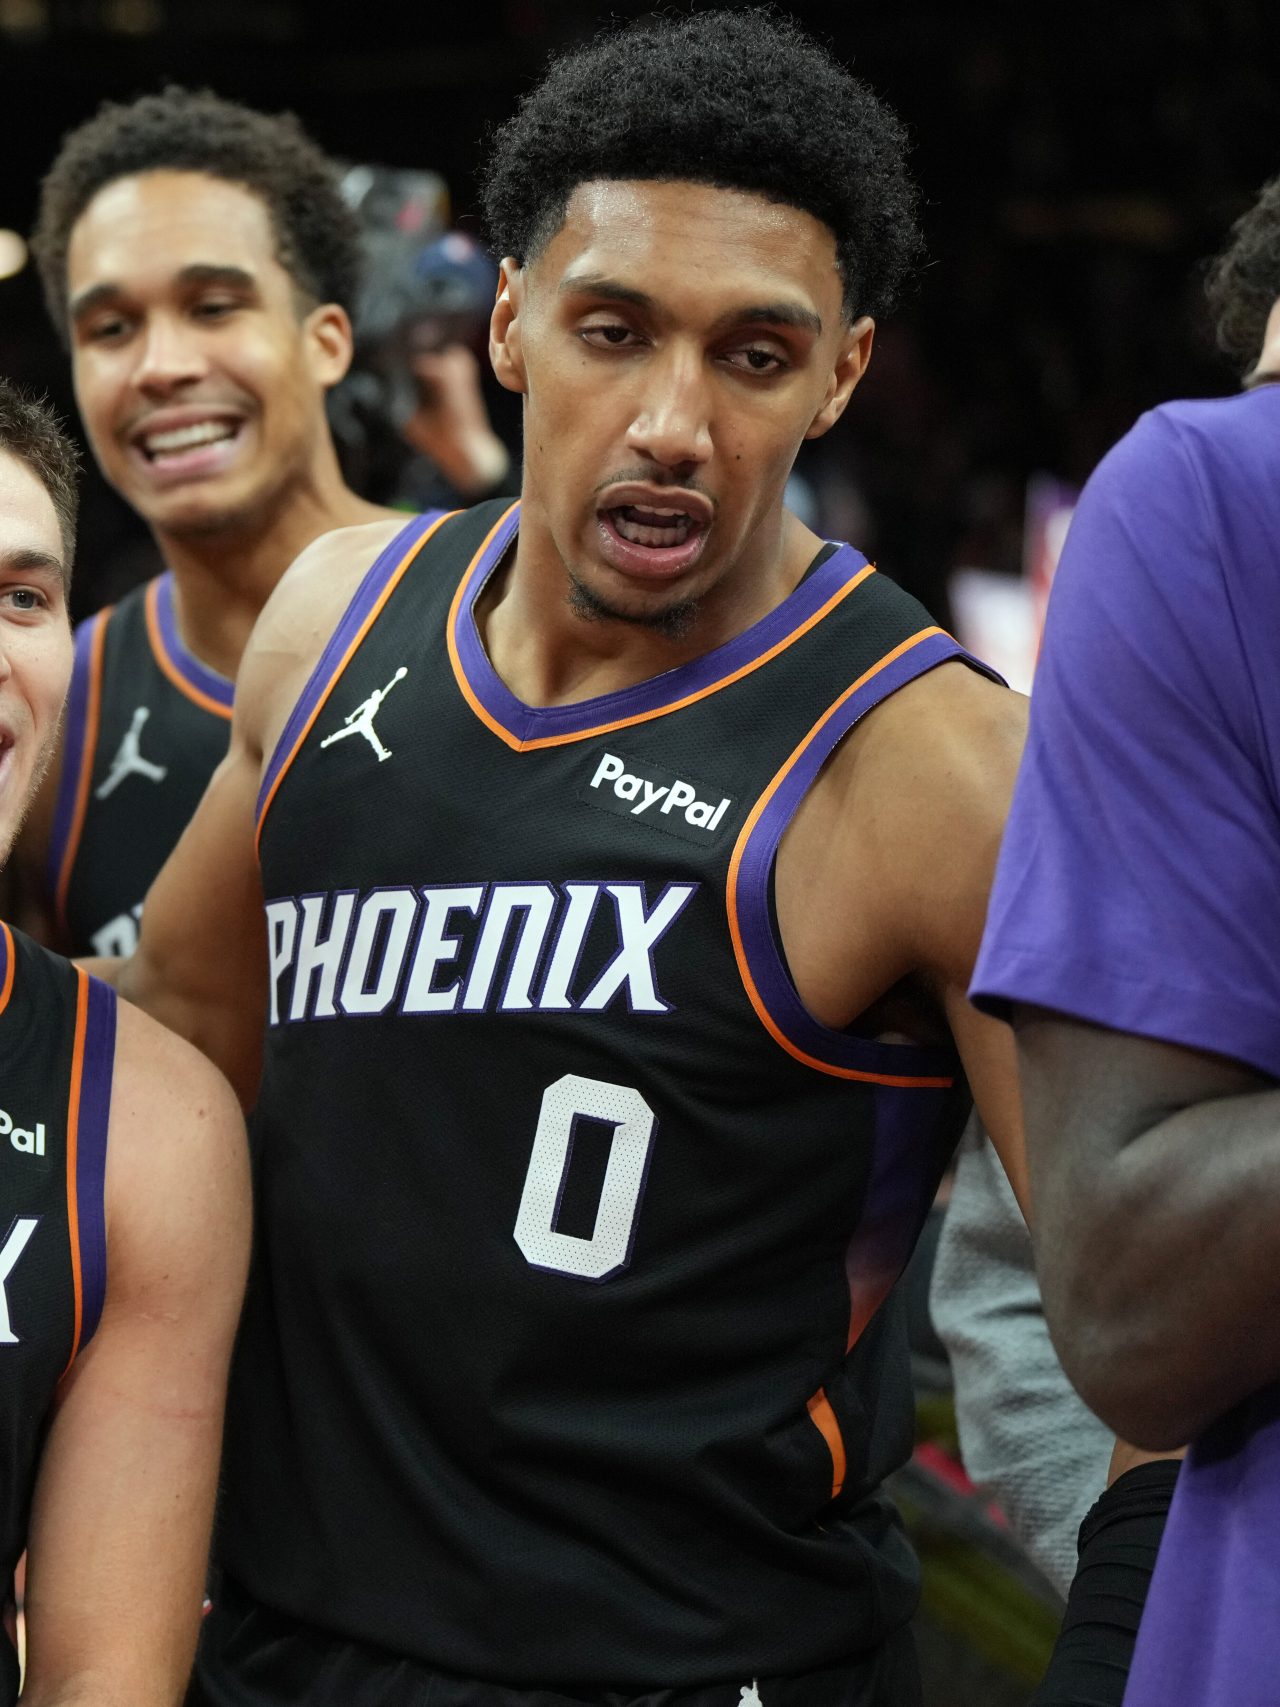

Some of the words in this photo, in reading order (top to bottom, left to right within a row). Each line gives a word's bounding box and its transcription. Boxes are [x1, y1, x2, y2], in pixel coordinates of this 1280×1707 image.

[590, 753, 731, 833] PayPal
[264, 881, 700, 1028] PHOENIX
[513, 1073, 659, 1284] 0
